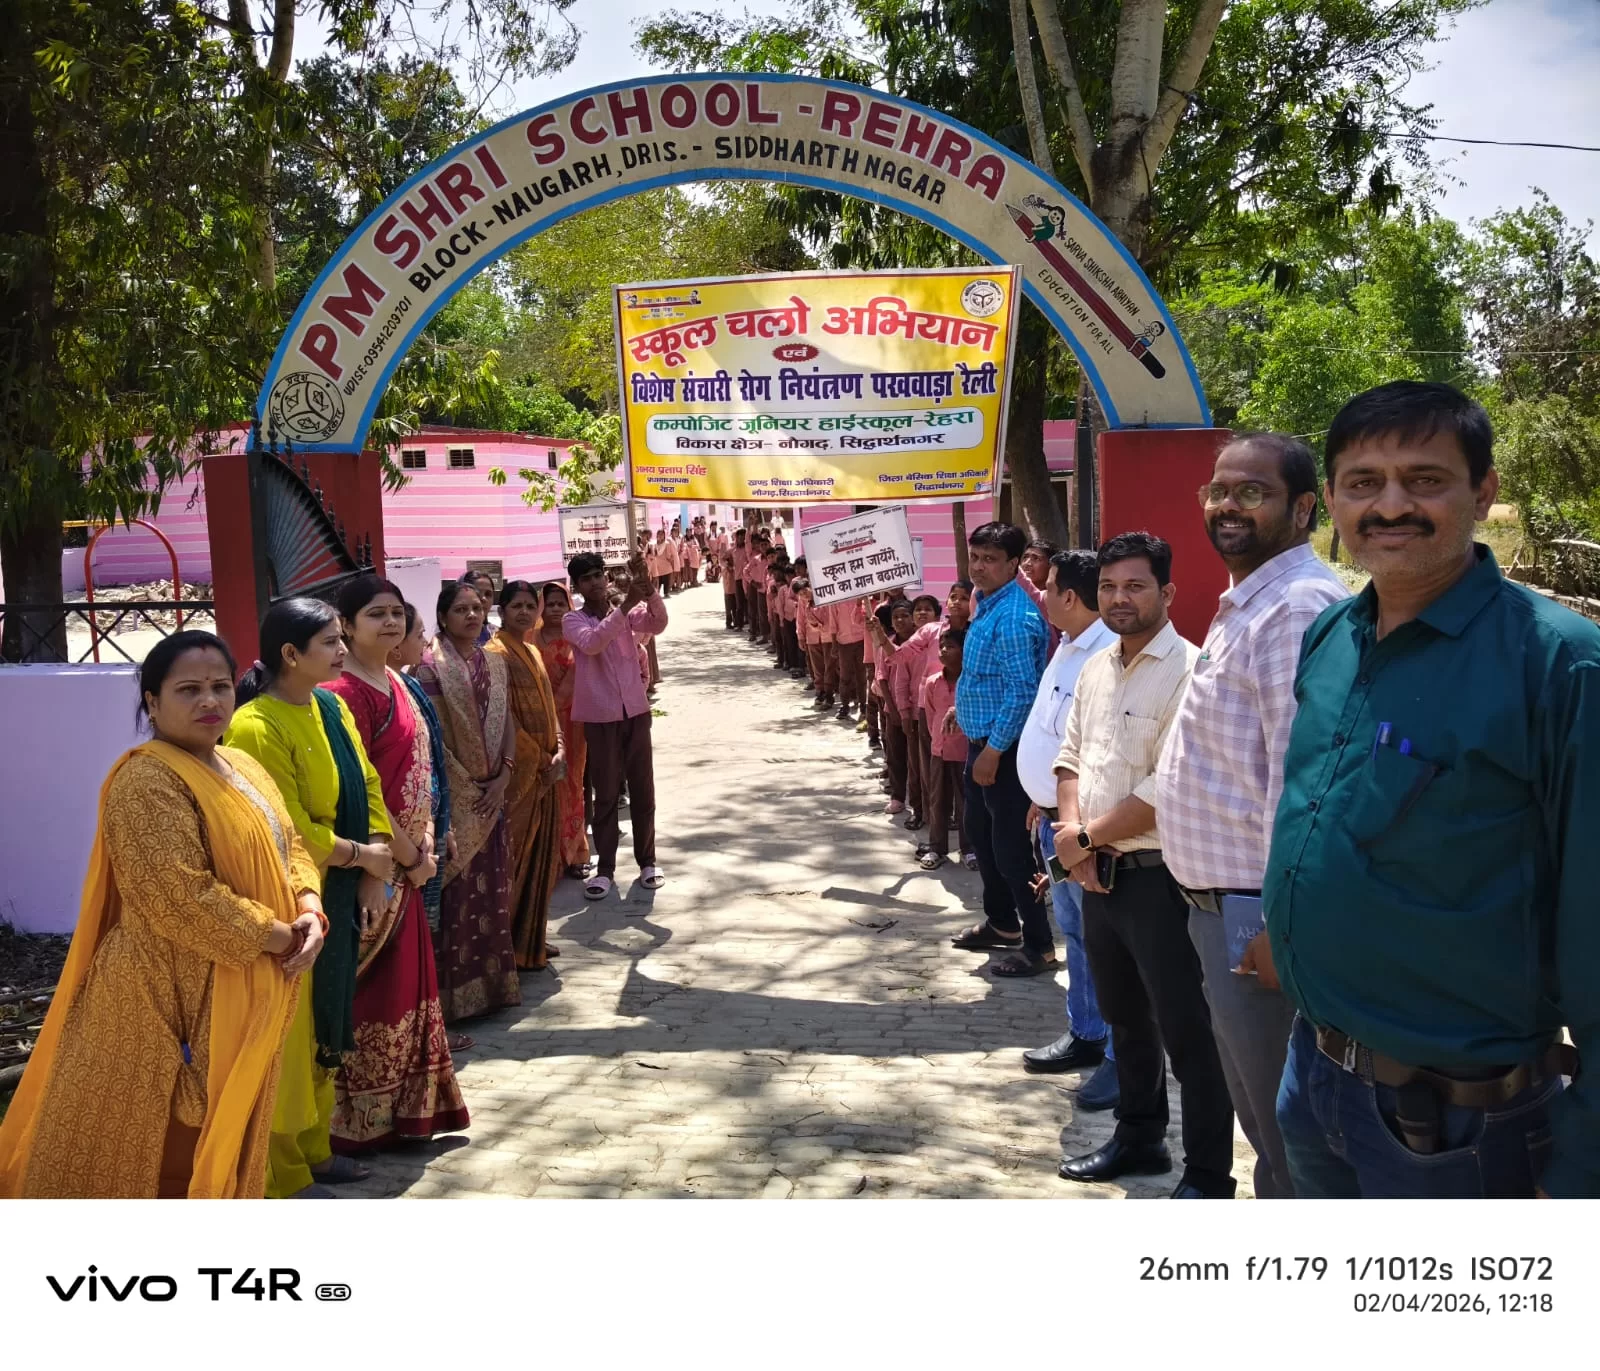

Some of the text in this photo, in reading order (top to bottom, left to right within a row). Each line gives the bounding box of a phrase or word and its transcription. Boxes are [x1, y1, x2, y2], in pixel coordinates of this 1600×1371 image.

[298, 262, 387, 382] PM
[373, 146, 508, 269] SHRI
[526, 82, 779, 166] SCHOOL
[1063, 237, 1088, 262] SARVA
[1083, 257, 1114, 291] SHIKSHA
[628, 295, 999, 367] स्कूल चलो अभियान
[1086, 321, 1102, 341] FOR
[1099, 339, 1114, 355] ALL
[782, 347, 808, 358] एवं
[631, 372, 676, 402] विशेष
[681, 370, 732, 402] संचारी
[738, 369, 771, 401] रोग
[778, 367, 864, 401] नियंत्रण
[956, 362, 998, 395] रैली
[653, 415, 733, 431] कम्पोजिट
[738, 414, 812, 433] जूनियर
[676, 436, 727, 449] विकास
[839, 432, 946, 450] सिद्धार्थनगर
[658, 465, 683, 474] प्रताप
[685, 464, 707, 476] सिंह
[822, 562, 847, 581] स्कूल
[848, 556, 864, 574] हम
[814, 583, 836, 598] पापा
[837, 578, 852, 592] का
[854, 572, 874, 588] मान
